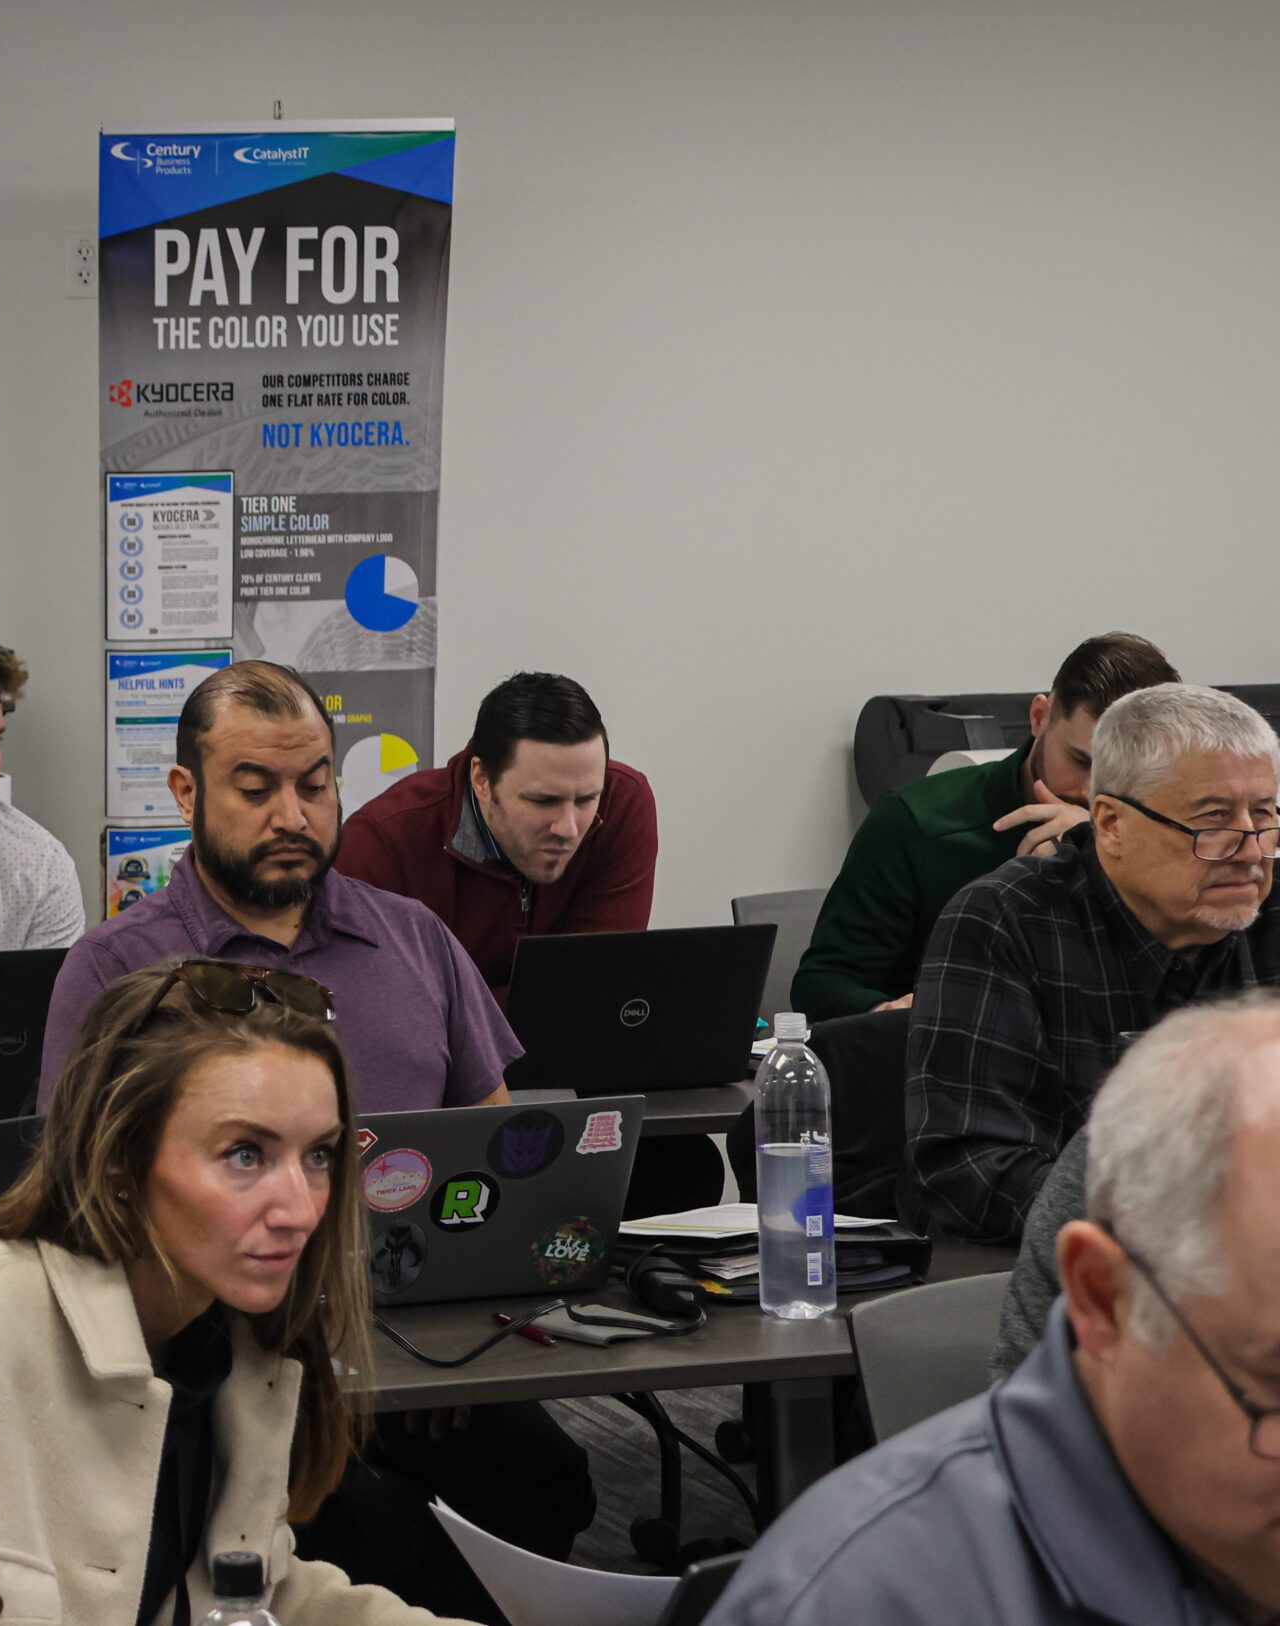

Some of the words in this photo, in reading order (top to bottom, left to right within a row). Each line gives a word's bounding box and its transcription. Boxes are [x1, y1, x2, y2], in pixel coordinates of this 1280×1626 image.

[146, 143, 202, 159] Century
[252, 147, 310, 162] CatalystIT
[156, 158, 191, 166] Business
[155, 167, 192, 175] Products
[154, 227, 266, 307] PAY
[286, 225, 400, 305] FOR
[153, 317, 201, 350] THE
[208, 315, 288, 349] COLOR
[296, 314, 345, 348] YOU
[352, 313, 400, 347] USE
[262, 374, 285, 389] OUR
[287, 372, 364, 388] COMPETITORS
[366, 372, 410, 387] CHARGE
[136, 382, 234, 403] KYOCERA
[262, 393, 284, 408] ONE
[287, 393, 314, 407] FLAT
[317, 392, 343, 407] RATE
[346, 392, 368, 406] FOR
[371, 391, 410, 406] COLOR.
[144, 408, 191, 418] Authorized
[194, 408, 223, 418] Dealer
[262, 423, 304, 448] NOT
[310, 421, 410, 447] KYOCERA.
[241, 497, 268, 514] TIER
[271, 496, 297, 513] ONE
[153, 509, 200, 523] KYOCERA
[241, 515, 286, 532] SIMPLE
[289, 514, 330, 531] COLOR
[286, 534, 326, 545] LETTERHEAD
[327, 534, 344, 544] WITH
[344, 533, 375, 543] COMPANY
[376, 533, 393, 543] LOGO
[240, 549, 254, 559] LOW
[255, 548, 288, 558] COVERAGE
[241, 574, 255, 584] 70%
[256, 574, 264, 583] OF
[265, 573, 295, 583] CENTURY
[295, 572, 322, 583] CLIENTS
[240, 586, 259, 597] PRINT
[260, 586, 272, 596] TIER
[273, 586, 288, 596] ONE
[289, 585, 311, 596] COLOR
[118, 678, 156, 690] HELPFUL
[159, 677, 185, 689] HINTS
[398, 1184, 417, 1192] LAND
[440, 1179, 490, 1224] R
[544, 1243, 589, 1261] LOVE
